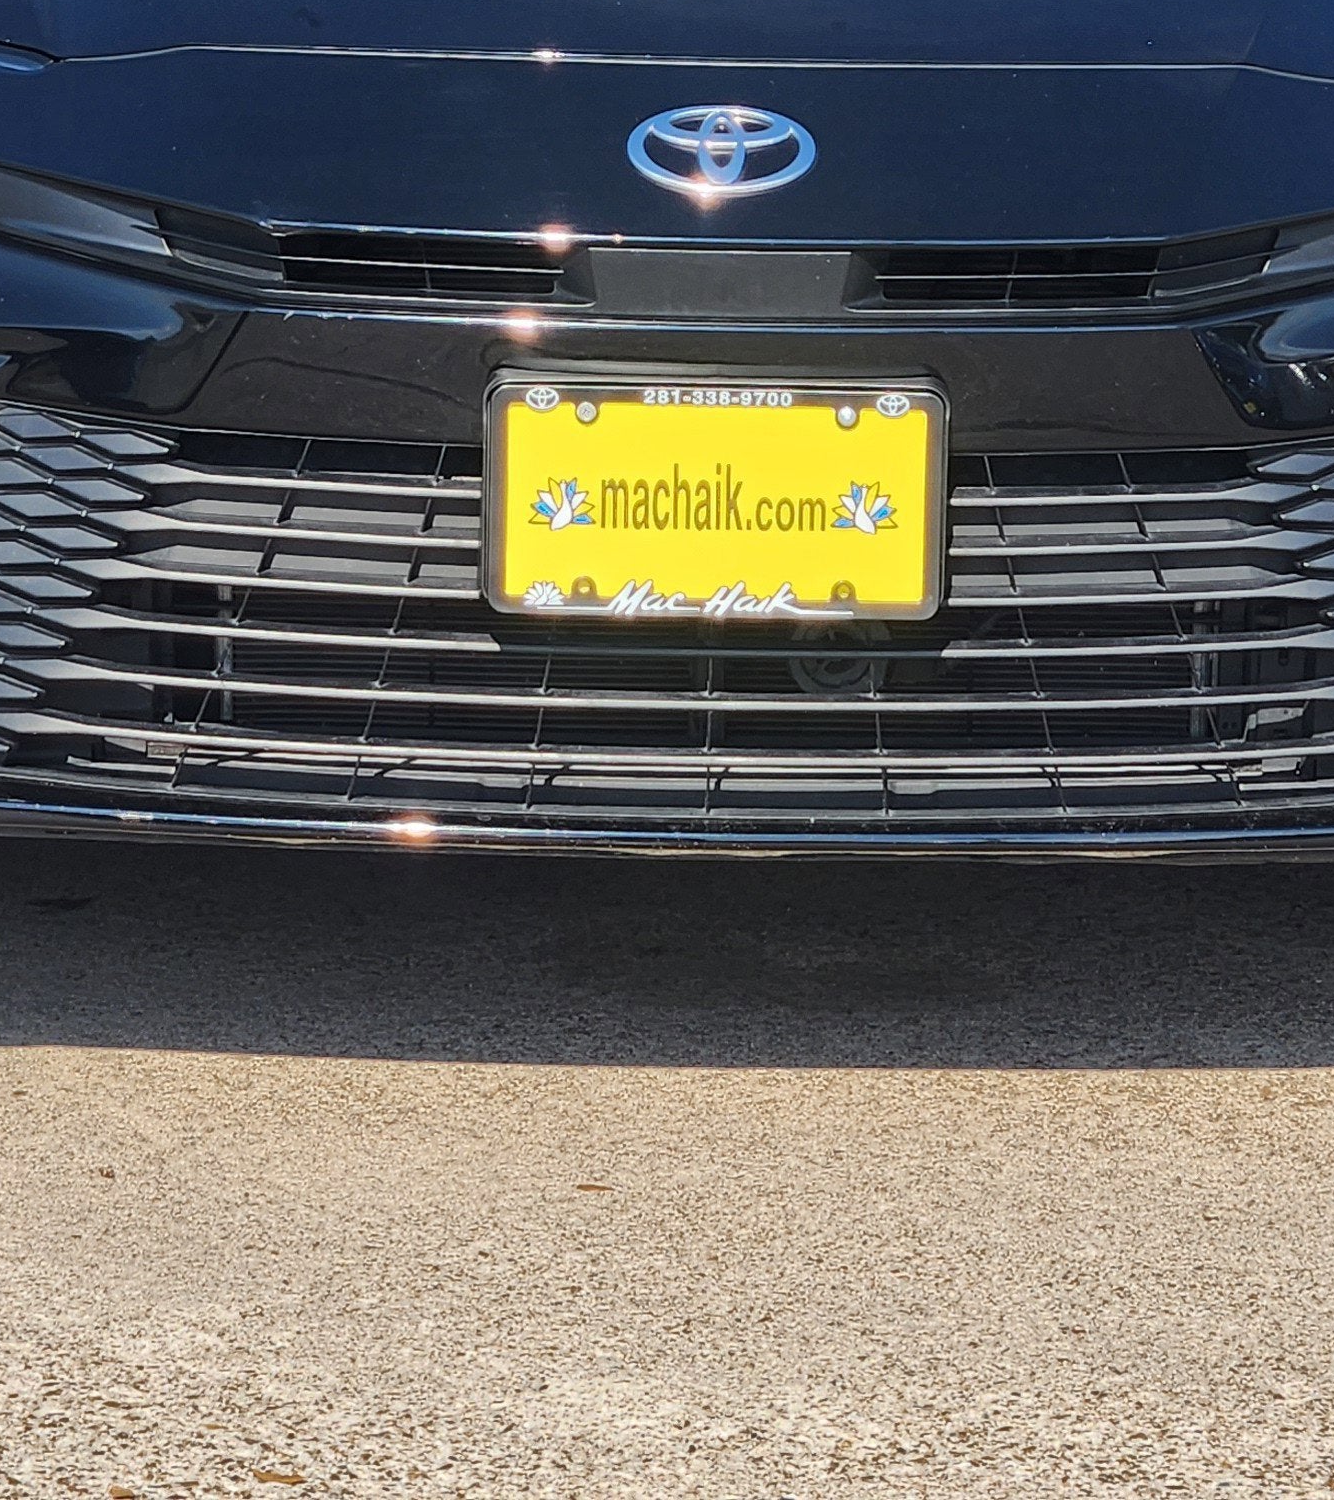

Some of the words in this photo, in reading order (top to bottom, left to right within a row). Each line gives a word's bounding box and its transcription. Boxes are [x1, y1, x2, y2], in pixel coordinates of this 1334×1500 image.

[643, 388, 794, 408] 281-338-9700
[600, 462, 827, 532] machaik.com
[606, 578, 698, 616] Mac
[703, 579, 799, 617] Haik
